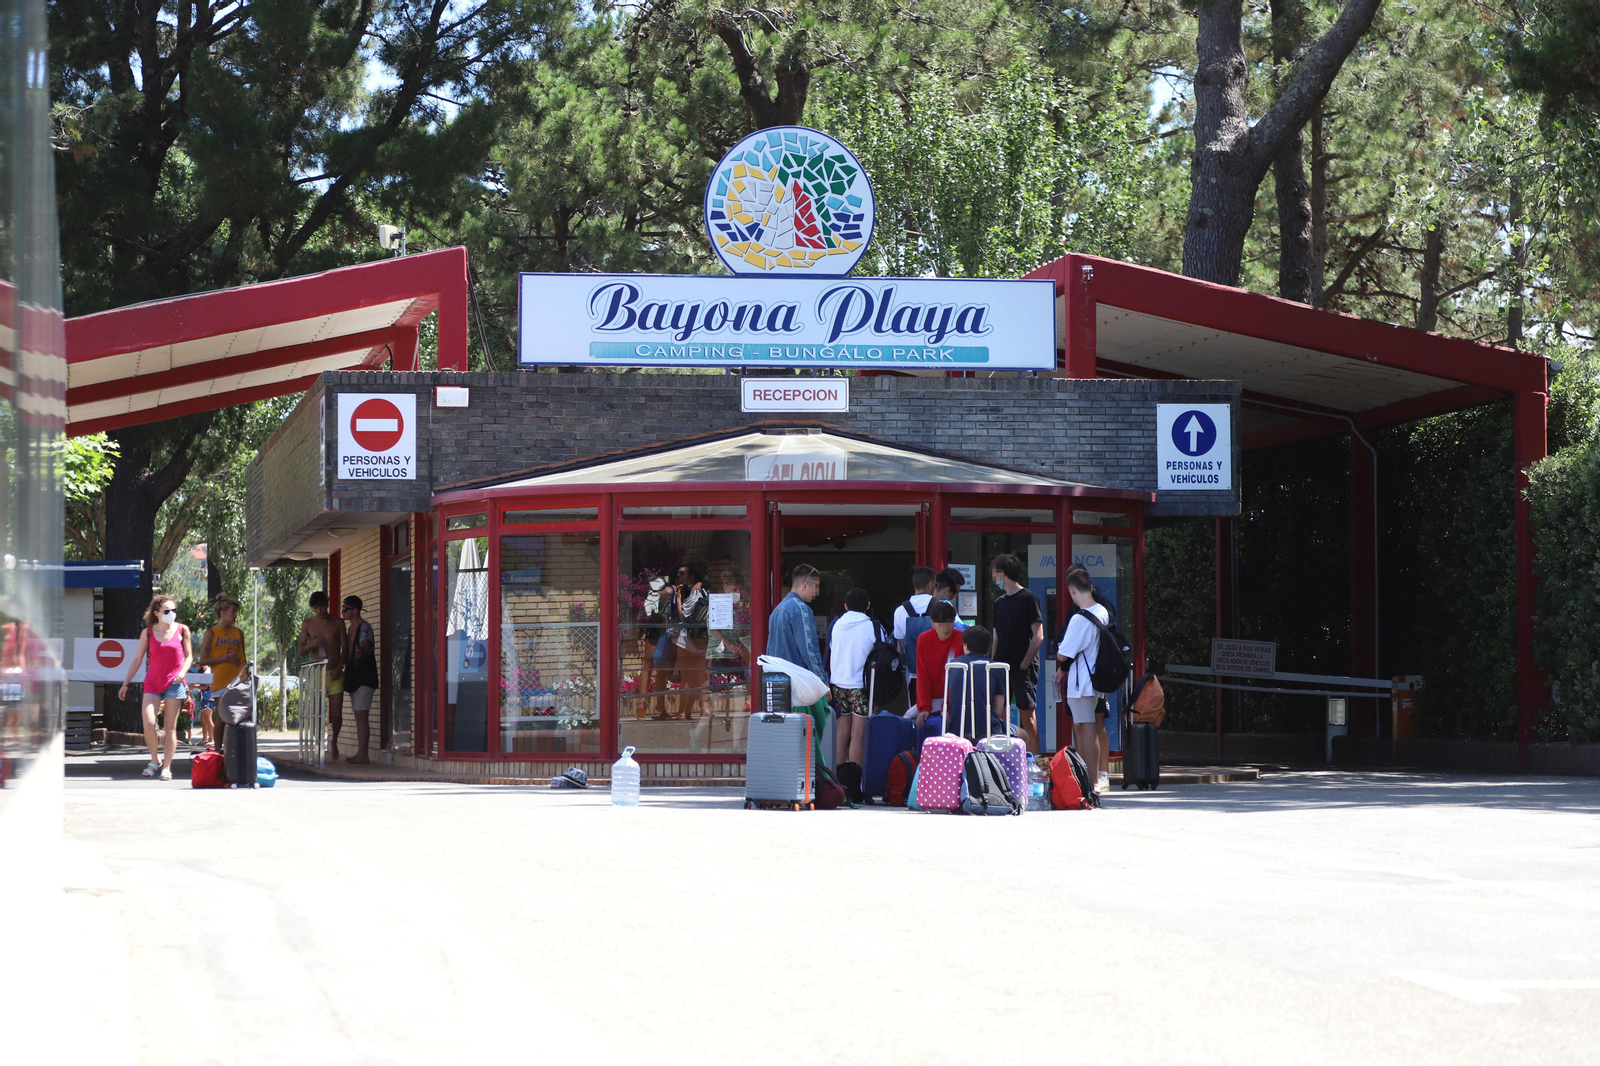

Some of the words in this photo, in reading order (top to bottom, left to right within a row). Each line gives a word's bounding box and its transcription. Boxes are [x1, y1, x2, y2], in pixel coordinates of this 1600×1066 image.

[590, 283, 801, 342] Bayona
[816, 283, 990, 344] Playa
[635, 344, 744, 358] CAMPING
[769, 346, 882, 359] BUNGALO
[892, 348, 955, 361] PARK
[752, 388, 838, 402] RECEPCION
[342, 455, 401, 466] PERSONAS
[404, 455, 412, 466] Y
[1166, 460, 1214, 471] PERSONAS
[1216, 460, 1223, 471] Y
[348, 467, 408, 478] VEHICULOS
[1170, 471, 1220, 484] VEHÍCULOS
